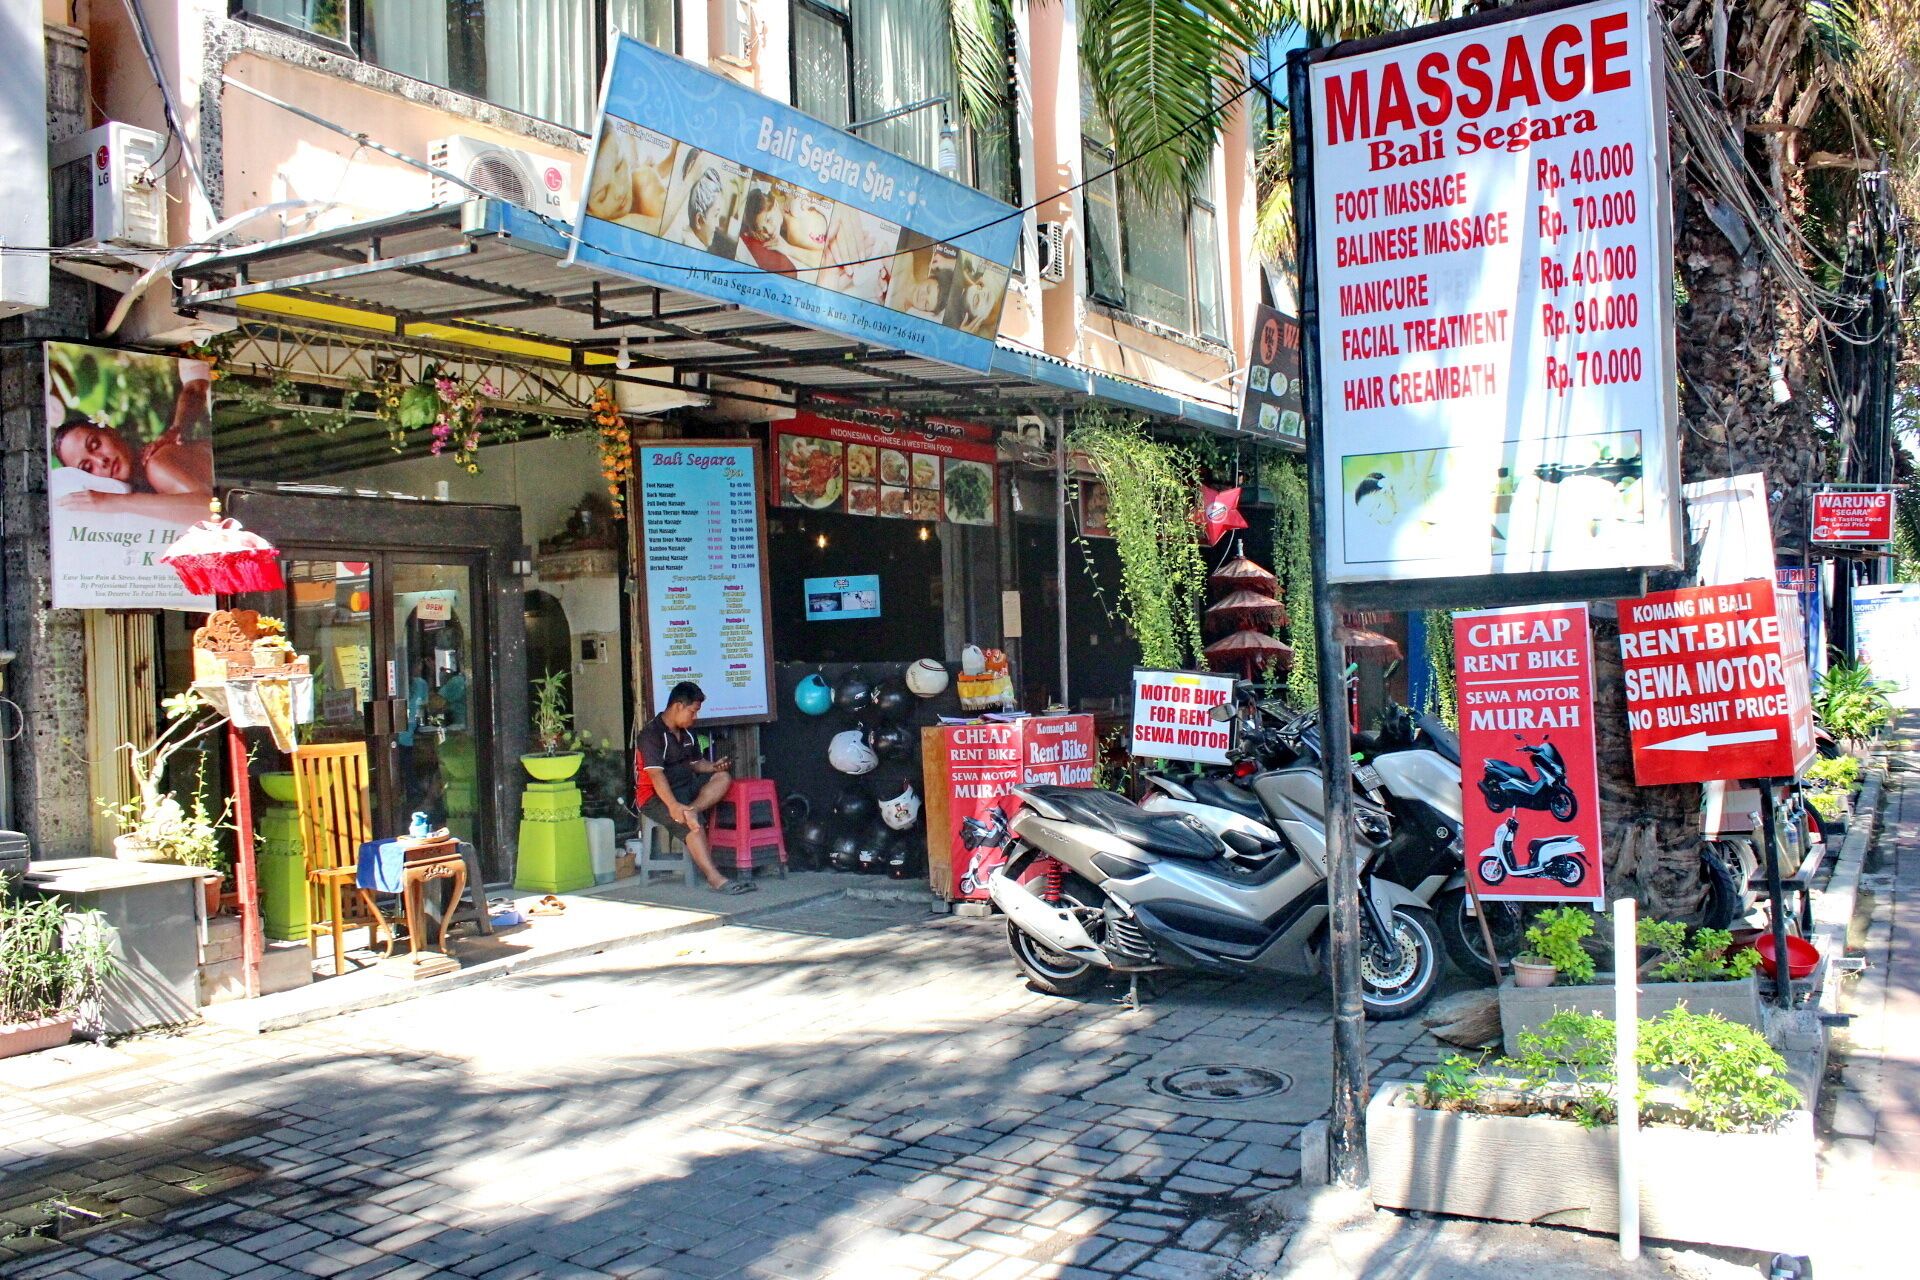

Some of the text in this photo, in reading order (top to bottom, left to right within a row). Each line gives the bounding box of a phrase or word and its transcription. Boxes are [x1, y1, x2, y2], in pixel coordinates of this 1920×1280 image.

[1324, 11, 1631, 146] MASSAGE
[645, 133, 670, 150] Massage
[1368, 109, 1598, 172] Bali Segara
[756, 115, 895, 203] Bali Segara Spa
[98, 172, 110, 187] LG
[1335, 142, 1634, 224] FOOT MASSAGE Rp. 40.000
[546, 193, 561, 206] LG
[1336, 189, 1636, 268] BALINESE MASSAGE Rp. 70.000
[1339, 273, 1429, 317] MANICURE
[1540, 256, 1568, 297] Rp.
[1572, 244, 1637, 287] 40.000
[703, 270, 729, 287] Wana
[730, 278, 761, 297] Segara
[763, 287, 779, 301] No.
[781, 293, 792, 304] 22
[794, 296, 821, 314] Tuban
[852, 313, 871, 329] Telp.
[1342, 293, 1638, 361] FACIAL TREATMENT Rp. 90.000
[1344, 346, 1642, 411] HAIR CREAMBATH Rp. 70.000
[873, 434, 901, 447] CHINESE
[906, 437, 936, 451] WESTERN
[936, 443, 953, 454] FOOD
[652, 451, 736, 470] Bali Segara
[723, 467, 744, 481] Spa
[1819, 495, 1886, 508] WARUNG
[68, 526, 142, 548] Massage
[142, 551, 155, 566] K
[90, 582, 127, 590] Professional
[425, 603, 443, 611] OPEN
[1632, 593, 1752, 623] KOMANG IN BALI
[1468, 617, 1571, 648] CHEAP
[1619, 615, 1780, 660] RENT.BIKE
[1463, 648, 1580, 673] RENT BIKE
[1624, 663, 1693, 702] SEWA
[1696, 652, 1786, 694] MOTOR
[1140, 684, 1227, 706] MOTOR BIKE
[1465, 686, 1580, 705] SEWA MOTOR
[1150, 705, 1213, 727] FOR RENT
[1470, 705, 1580, 731] MURAH
[1627, 693, 1789, 731] NO BULSHIT PRICE
[952, 728, 1011, 745] CHEAP
[1036, 722, 1078, 736] Komang Bali
[1135, 724, 1228, 749] SEWA MOTOR
[950, 748, 1017, 761] RENT BIKE
[1029, 739, 1088, 764] Rent Bike
[951, 770, 1017, 781] SEWA MOTOR
[1024, 764, 1094, 786] Sewa Motor
